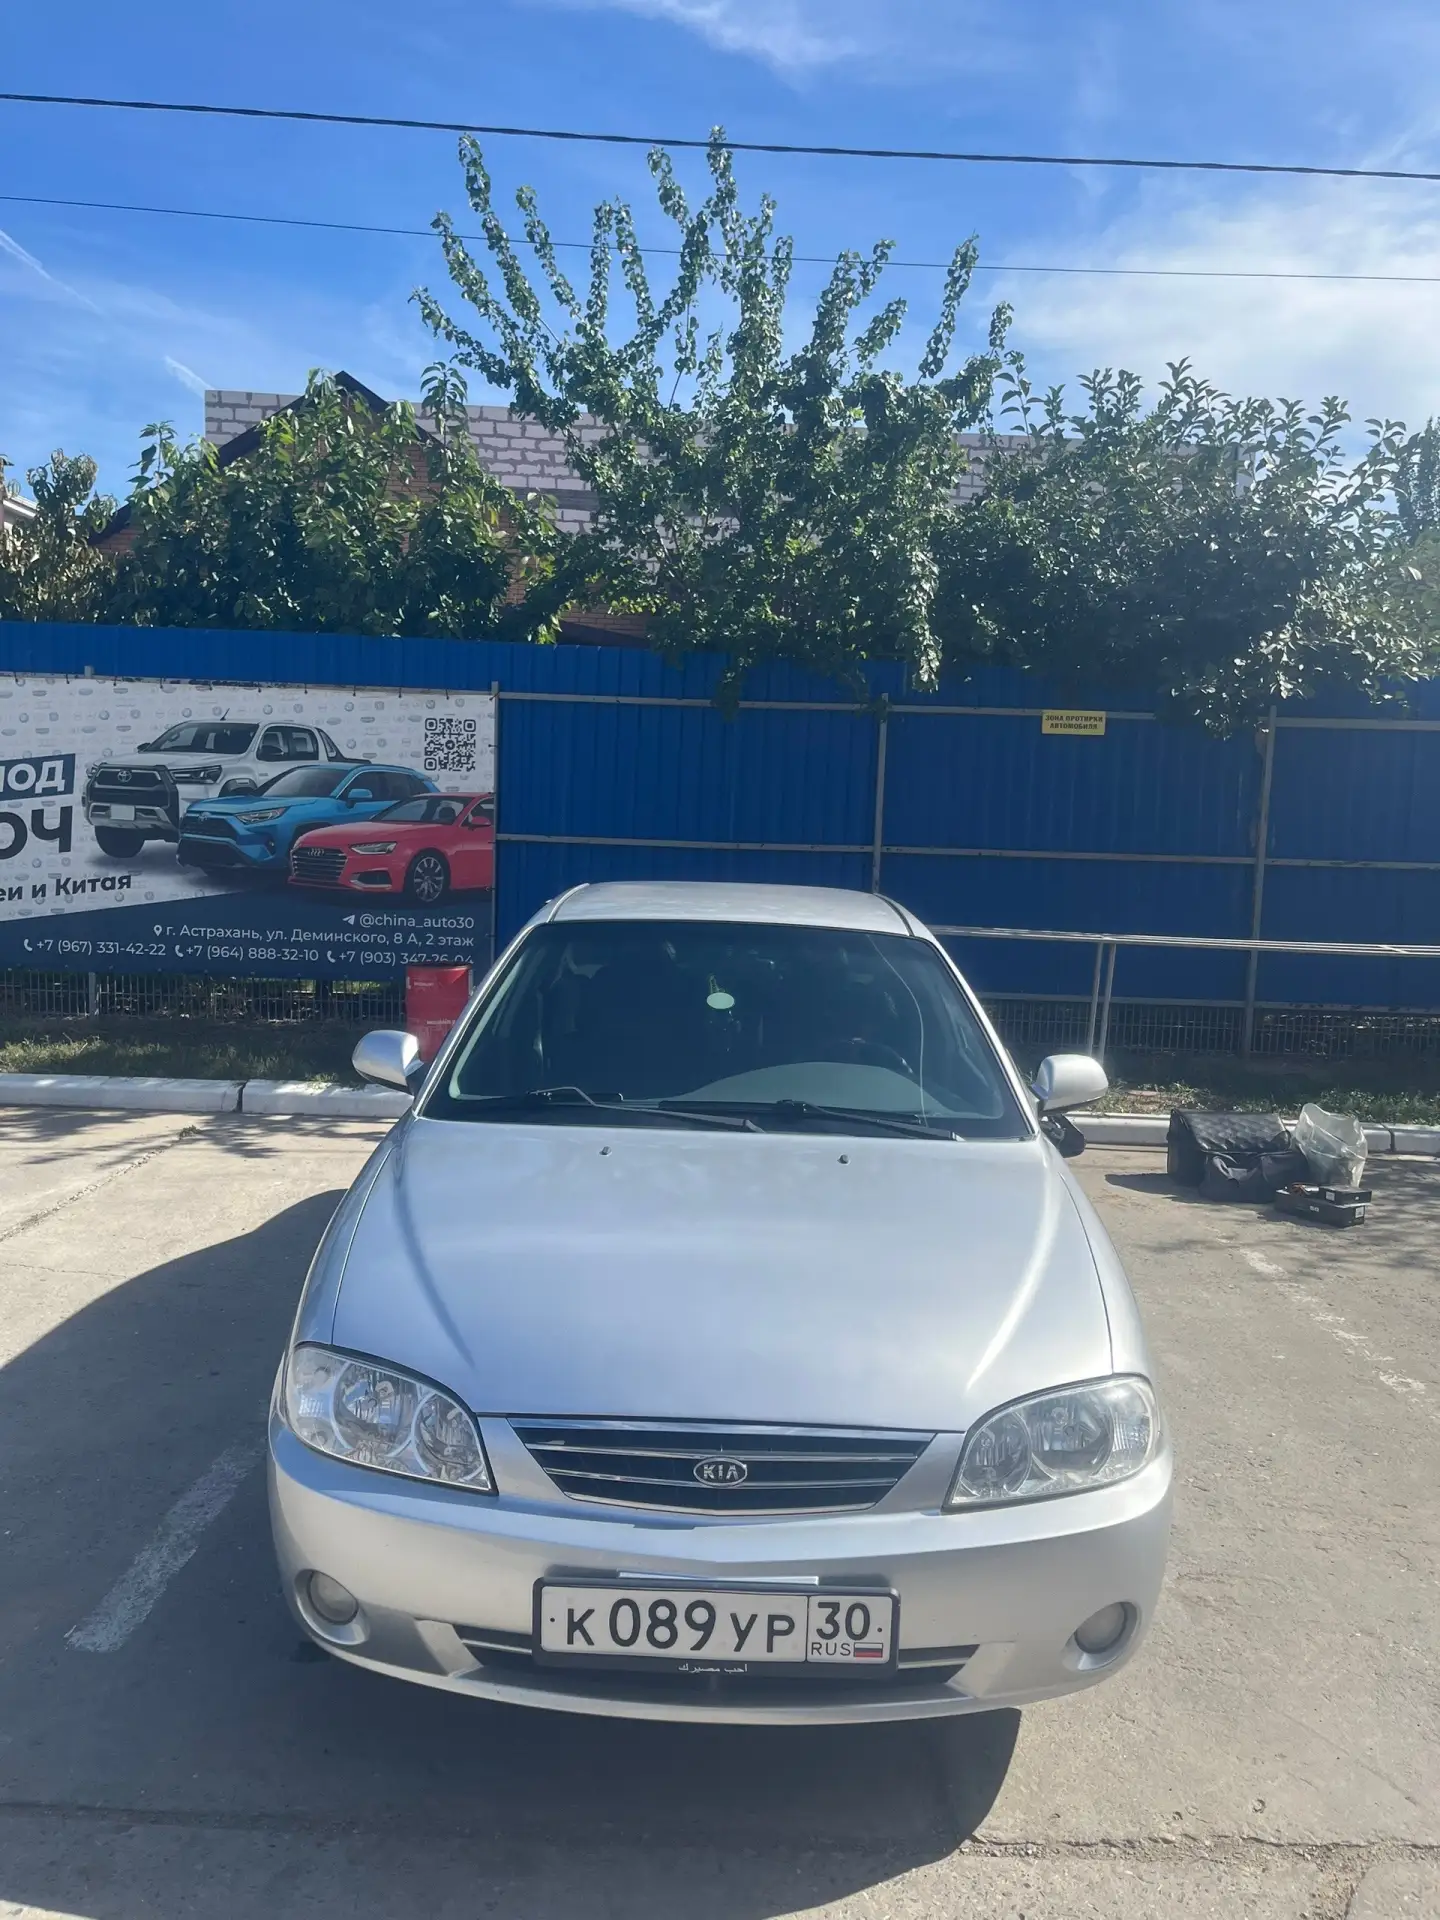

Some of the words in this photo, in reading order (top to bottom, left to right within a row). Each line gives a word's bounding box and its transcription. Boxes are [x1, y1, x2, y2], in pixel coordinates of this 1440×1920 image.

[0, 760, 66, 794] од
[32, 884, 46, 899] и
[55, 875, 132, 896] Китая
[360, 913, 475, 929] @china_auto30
[166, 926, 176, 936] г.
[180, 924, 263, 941] Астрахань,
[266, 930, 287, 942] ул.
[291, 929, 390, 945] Деминского,
[393, 933, 403, 945] 8
[407, 933, 422, 947] А,
[425, 933, 434, 946] 2
[438, 935, 474, 947] этаж
[36, 940, 54, 952] +7
[58, 940, 92, 955] (967)
[97, 941, 166, 956] 331-42-22
[186, 946, 203, 957] +7
[207, 946, 244, 961] (964)
[248, 948, 319, 961] 888-32-10
[339, 951, 356, 963] +7
[360, 952, 396, 966] (903)
[400, 953, 474, 964] 347-2604
[703, 1464, 739, 1479] KIA
[816, 1602, 870, 1640] 30
[811, 1642, 851, 1656] RUS
